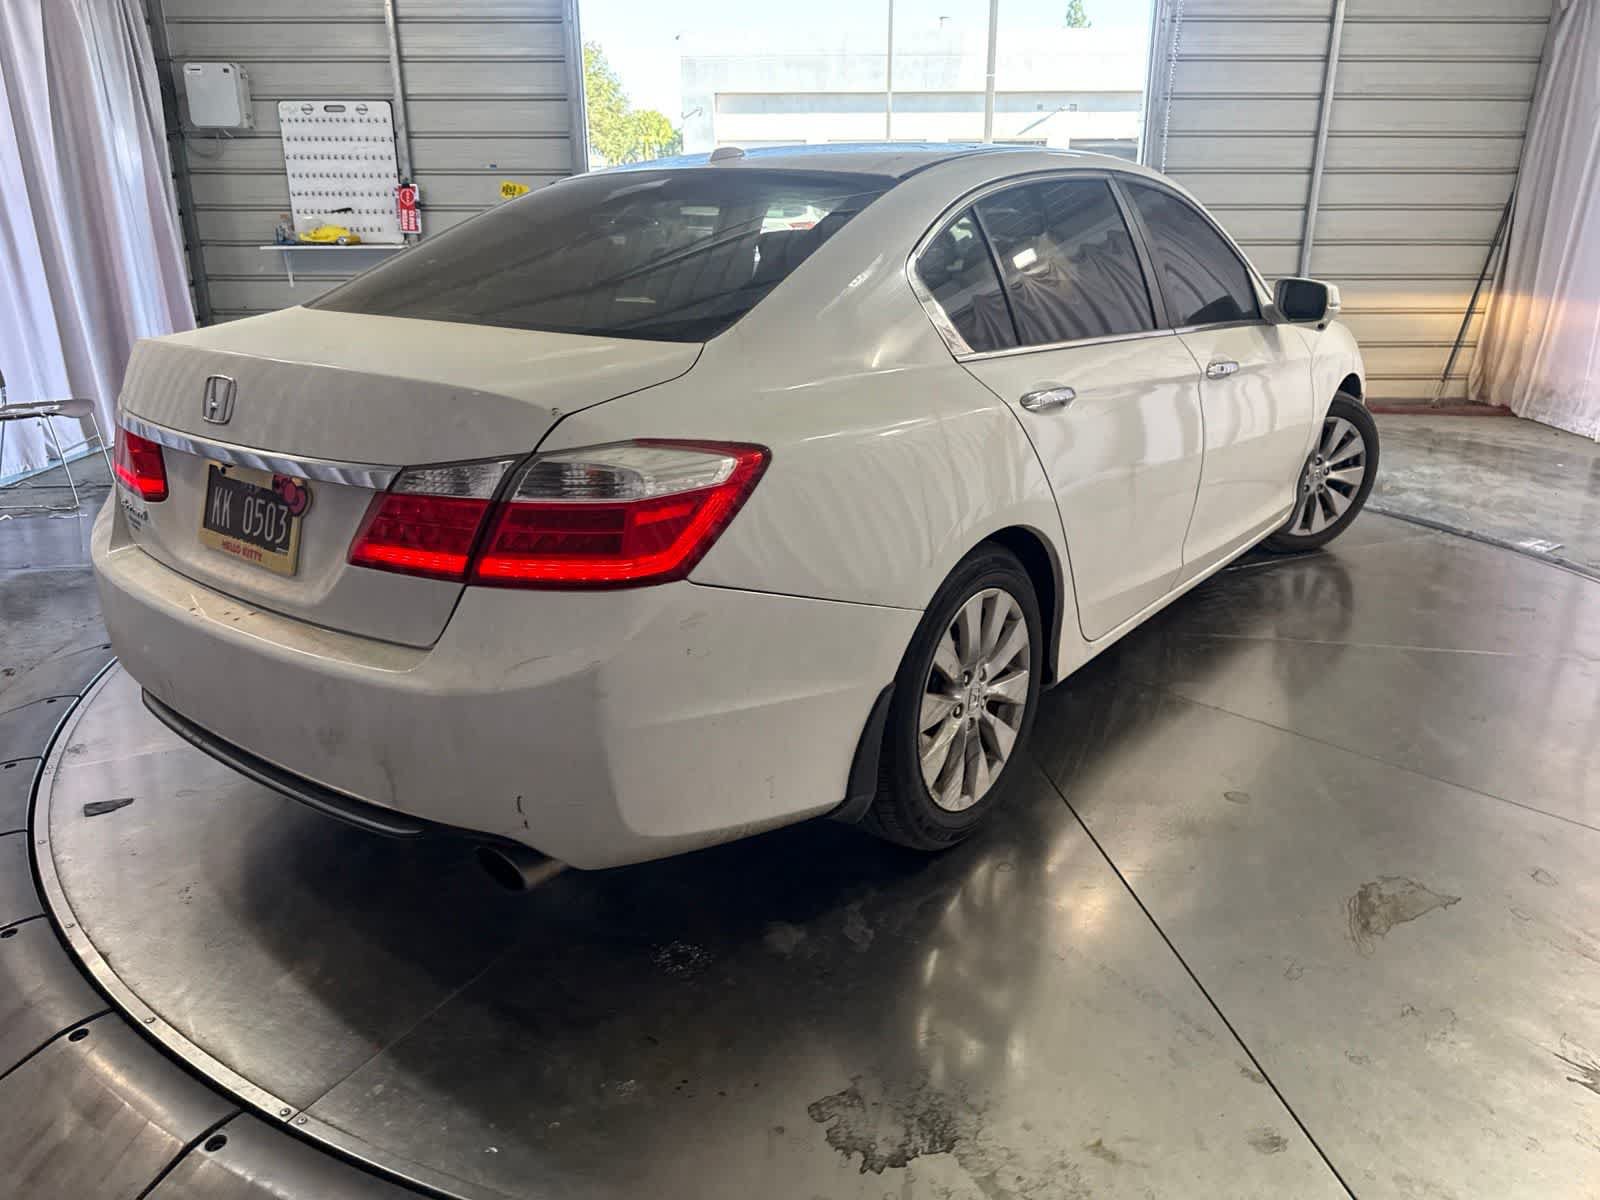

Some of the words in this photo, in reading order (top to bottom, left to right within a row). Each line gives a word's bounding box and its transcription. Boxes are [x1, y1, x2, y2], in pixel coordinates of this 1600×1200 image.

[211, 487, 233, 528] KK
[242, 496, 289, 544] 0503
[223, 541, 241, 554] HELLO
[242, 547, 262, 562] KITTY
